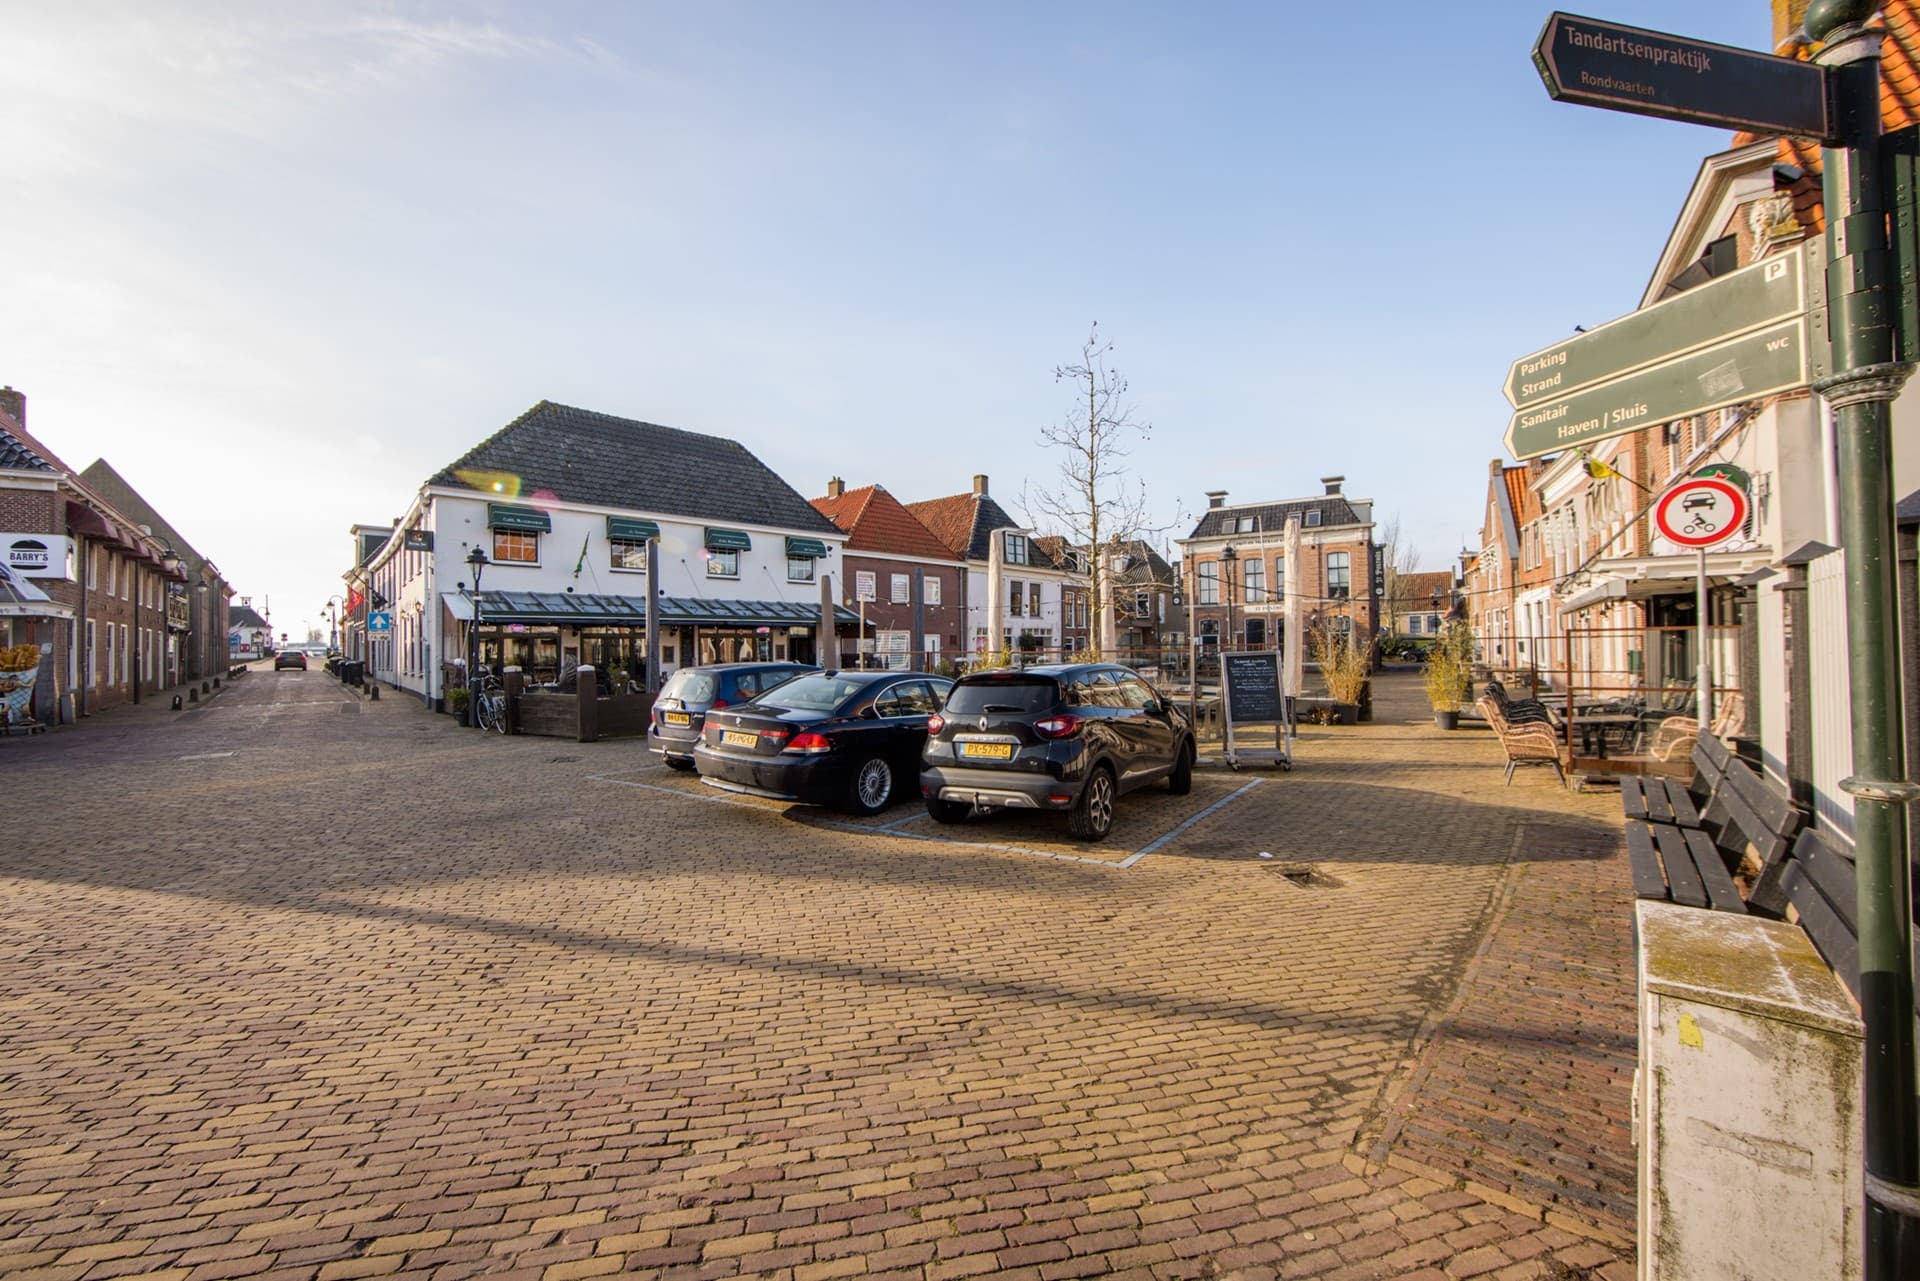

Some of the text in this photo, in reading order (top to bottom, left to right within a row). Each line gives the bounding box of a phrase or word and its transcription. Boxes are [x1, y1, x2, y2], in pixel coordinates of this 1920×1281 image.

[1564, 26, 1712, 73] Tandartsenpraktijk
[1581, 71, 1656, 97] Rondvaarten
[1769, 263, 1781, 278] P
[1765, 337, 1790, 352] WC
[1520, 351, 1567, 377] Parking
[1521, 372, 1561, 397] Strand
[1520, 404, 1569, 429] Sanitair
[1557, 418, 1600, 439] Haven
[1612, 403, 1648, 424] Sluis
[10, 552, 49, 562] BARRY'S
[967, 743, 1009, 756] PX-579-G
